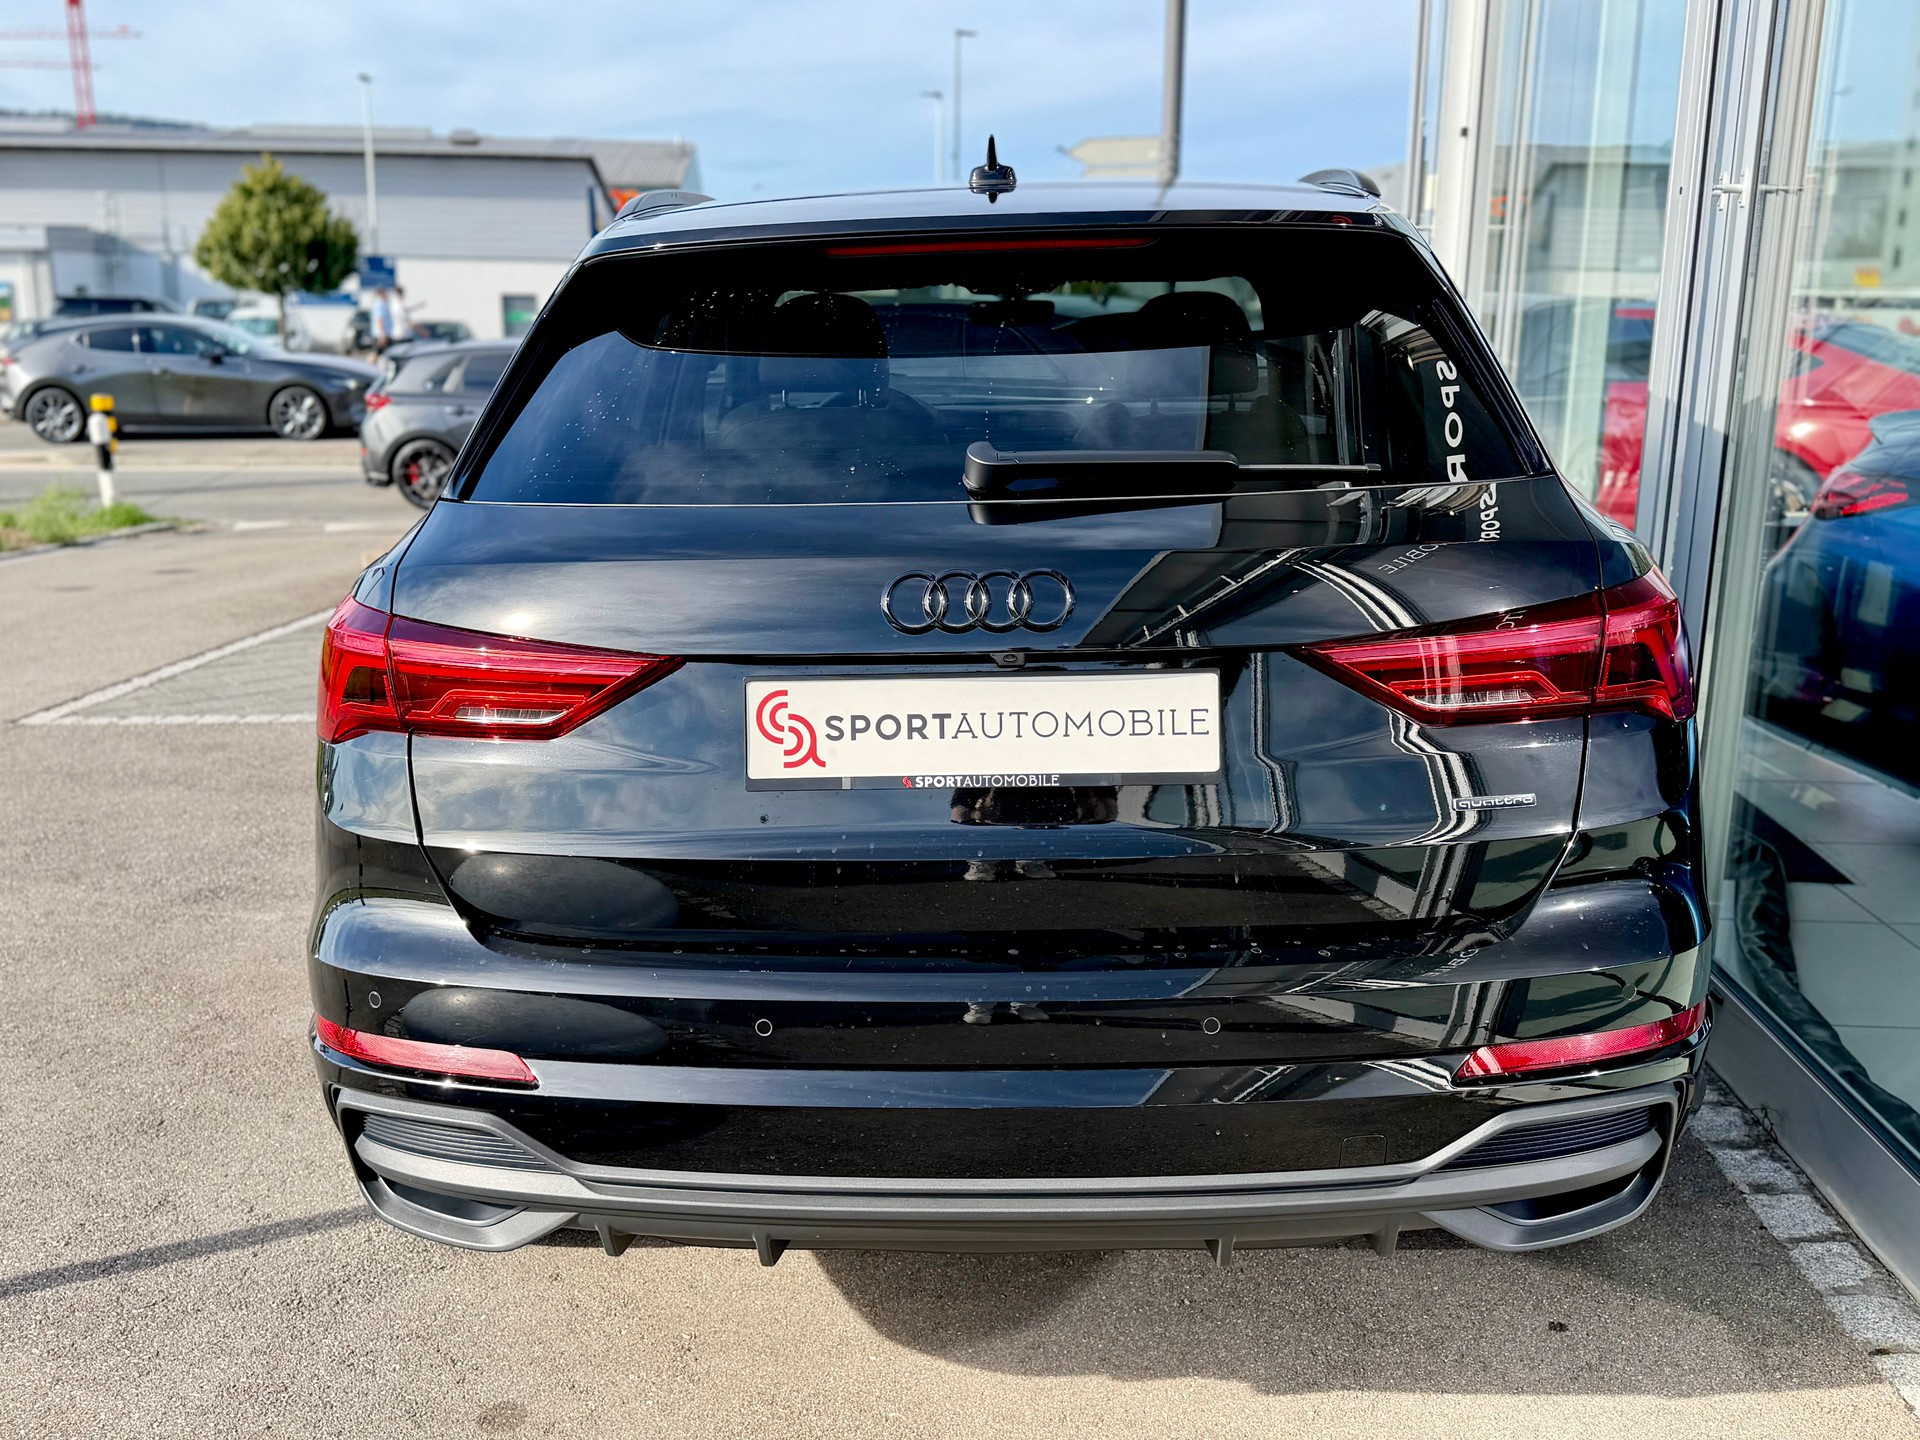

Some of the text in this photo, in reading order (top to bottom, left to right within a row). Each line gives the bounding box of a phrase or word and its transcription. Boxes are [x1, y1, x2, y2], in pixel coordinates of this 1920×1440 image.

[825, 708, 1209, 742] SPORTAUTOMOBILE
[915, 774, 1060, 788] SPORTAUTOMOBILE
[1458, 796, 1535, 809] quattro
